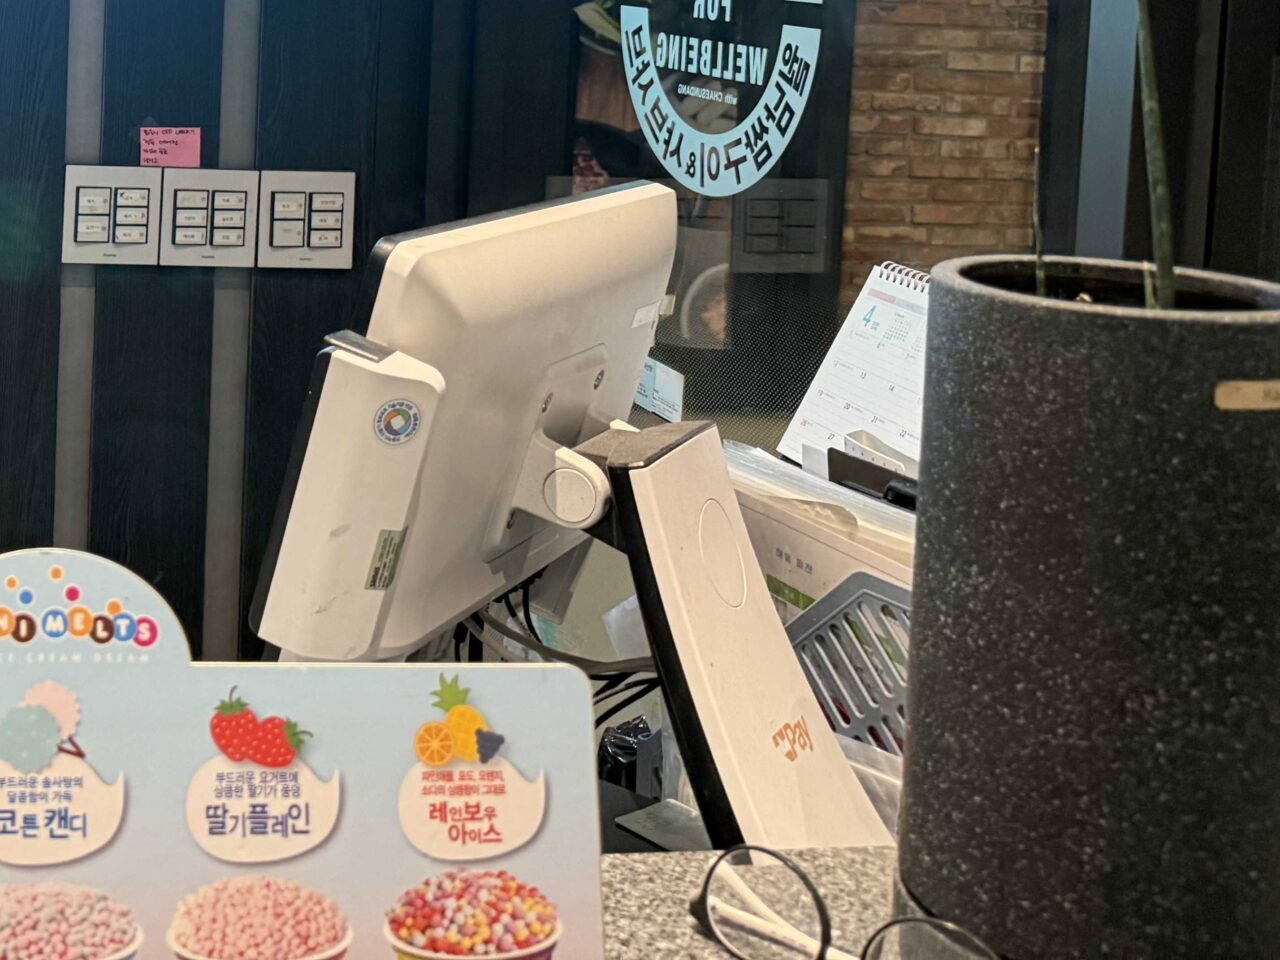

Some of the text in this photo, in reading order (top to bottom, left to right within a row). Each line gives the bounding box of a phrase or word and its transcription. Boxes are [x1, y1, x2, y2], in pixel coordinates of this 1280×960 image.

[862, 305, 877, 327] 4
[43, 608, 156, 645] MELTS
[41, 776, 84, 788] 솜사탕의
[215, 771, 299, 784] 부드러운 요거트에
[7, 790, 73, 803] 달콤함이 가득
[214, 784, 244, 798] 상큼한
[247, 784, 278, 798] 딸기가
[43, 807, 87, 839] 캔디
[428, 801, 498, 823] 레인보우
[447, 822, 504, 845] 아이스
